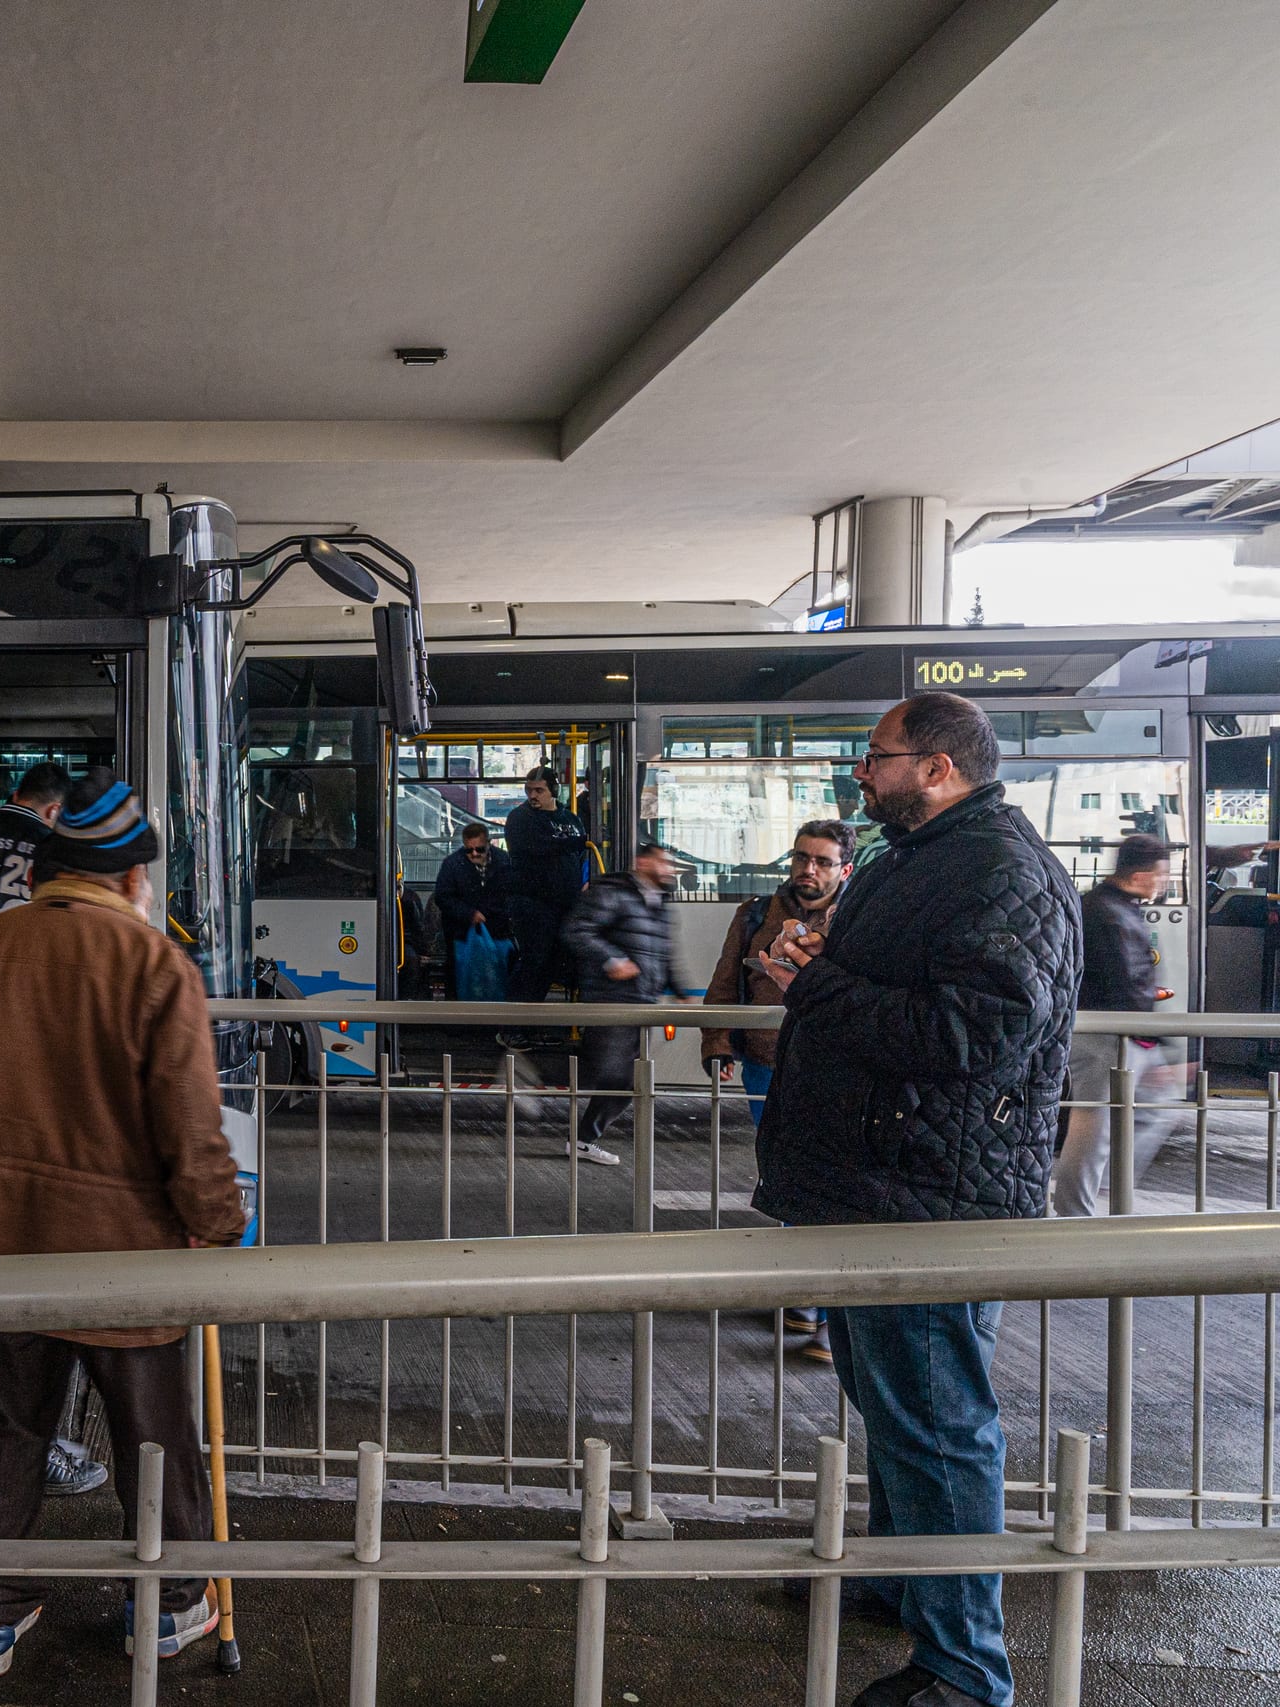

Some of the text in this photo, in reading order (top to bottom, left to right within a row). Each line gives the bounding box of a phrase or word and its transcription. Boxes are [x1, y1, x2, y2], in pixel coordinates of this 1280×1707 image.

[918, 661, 964, 684] 100
[17, 841, 36, 855] OF
[1168, 910, 1183, 924] C
